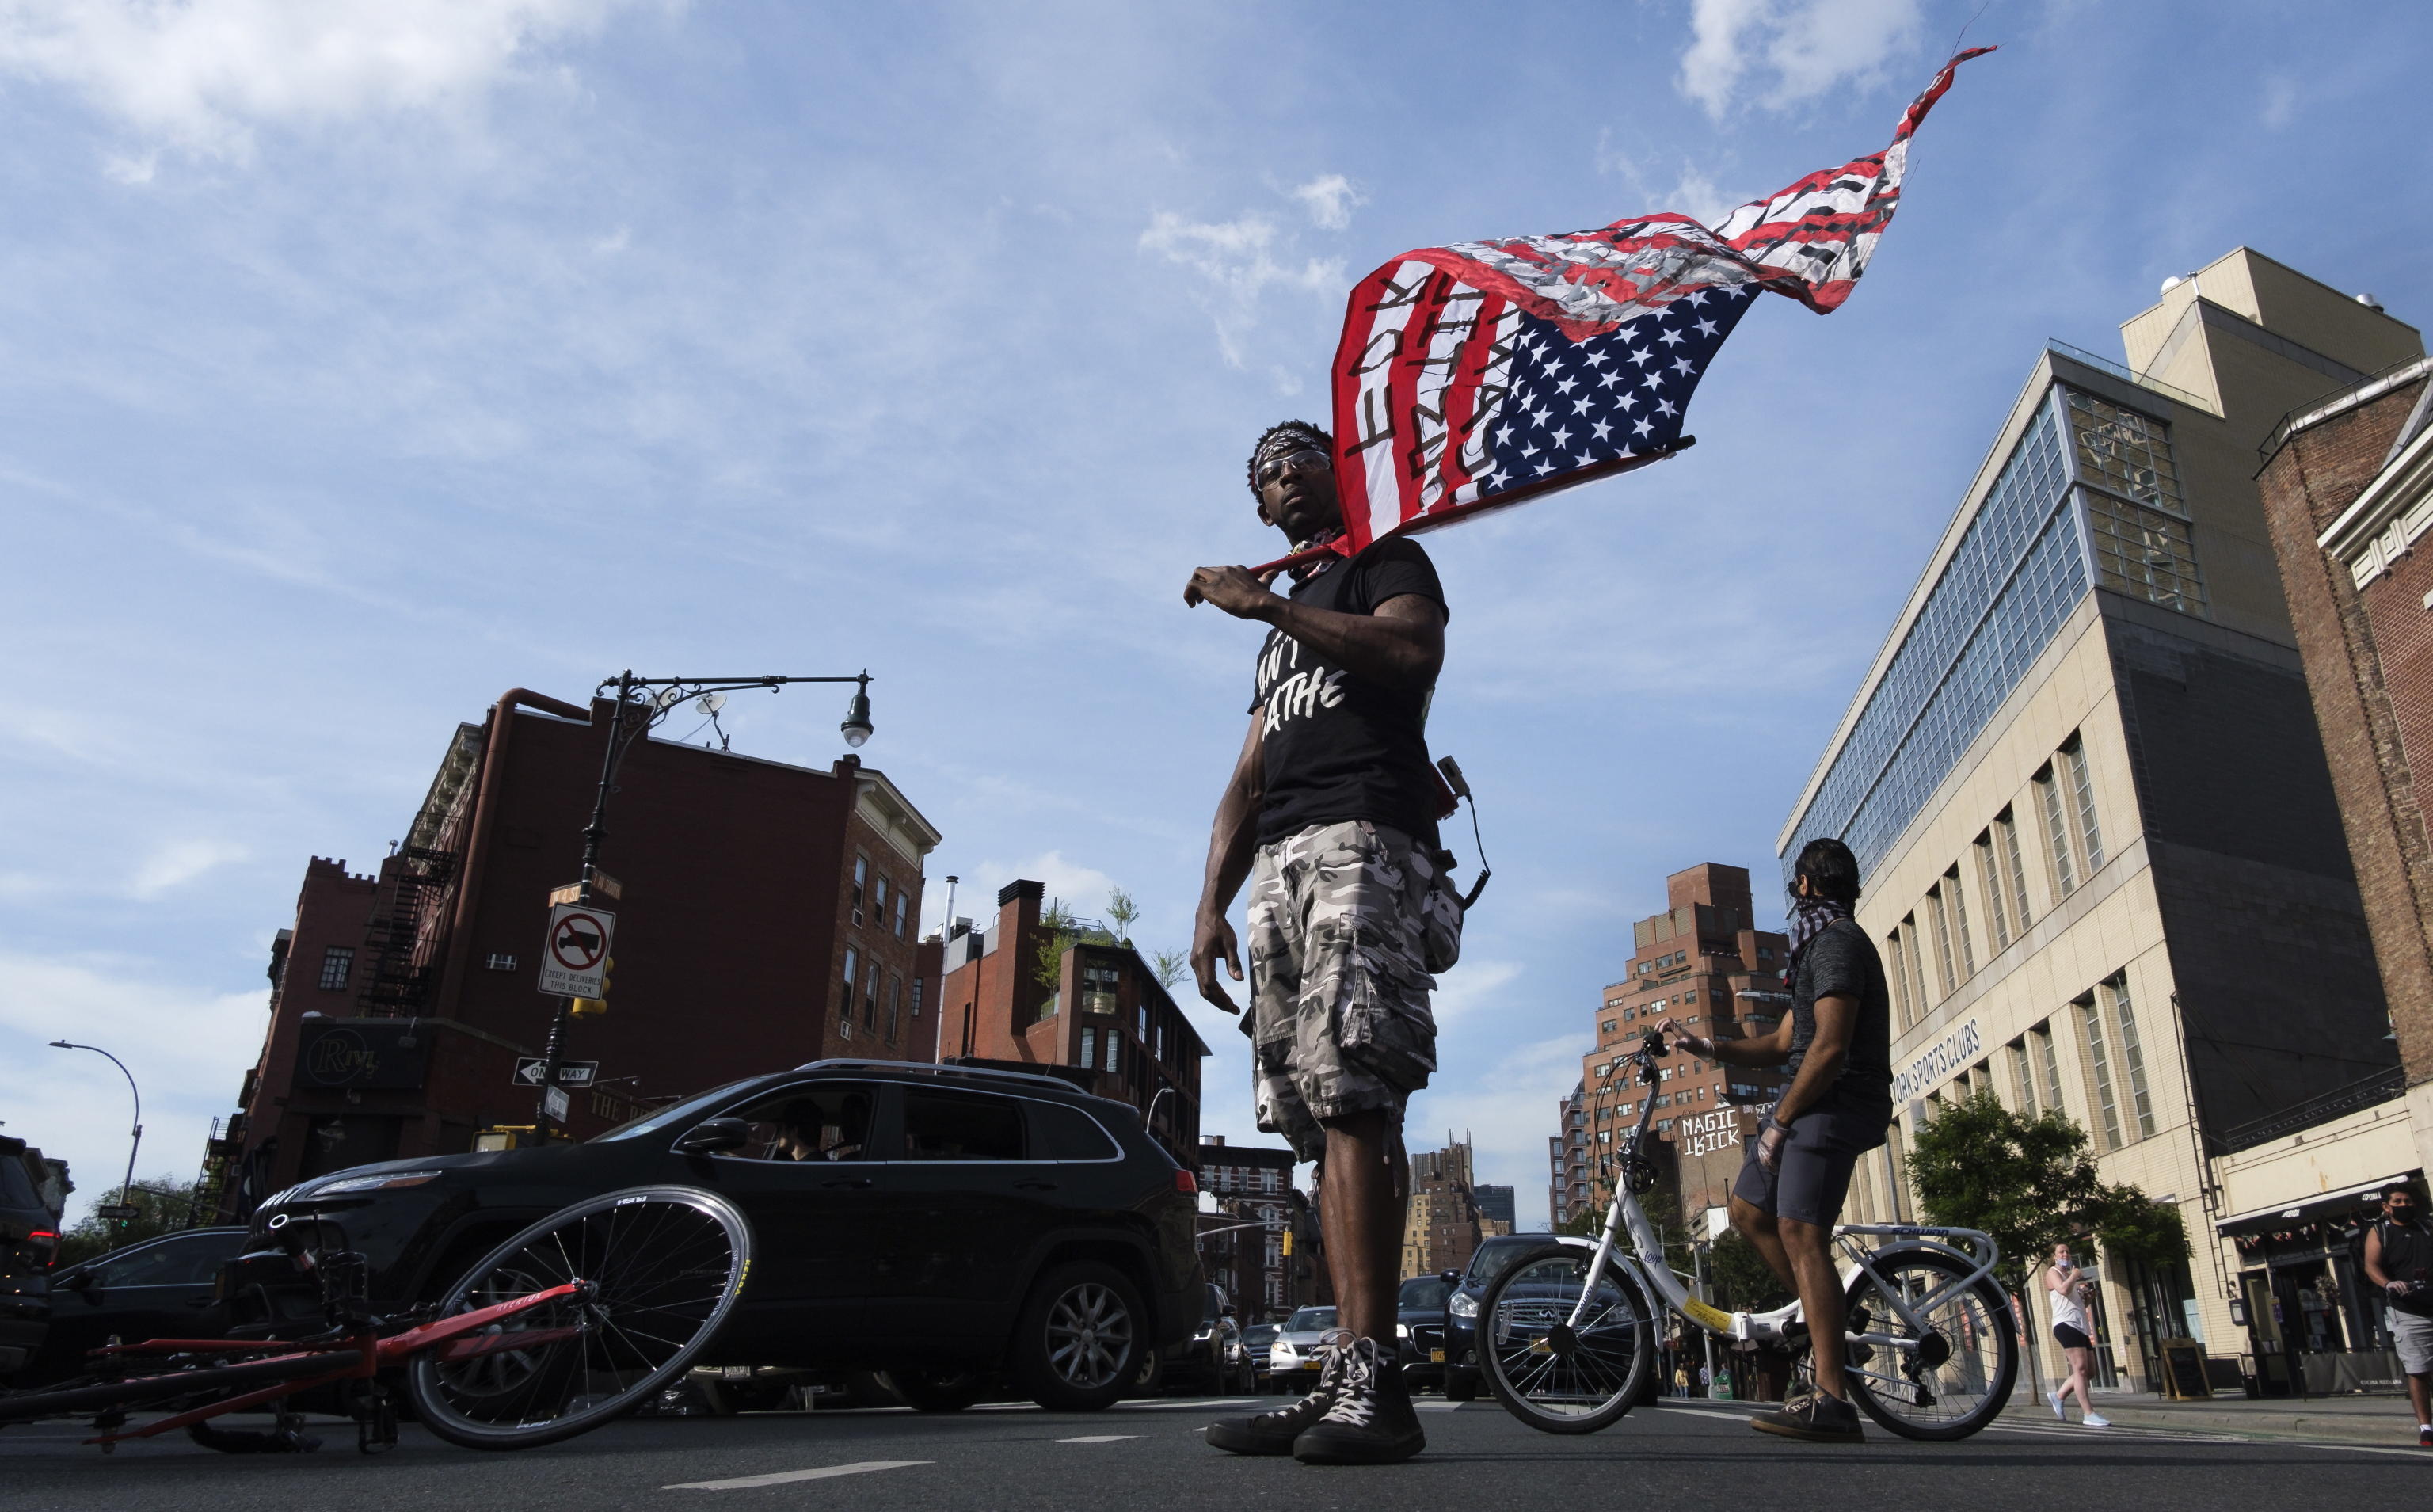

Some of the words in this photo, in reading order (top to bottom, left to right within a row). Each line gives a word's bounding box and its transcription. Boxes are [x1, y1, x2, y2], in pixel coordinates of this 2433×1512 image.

[544, 969, 566, 980] EXCEPT
[569, 973, 601, 986] DELIVERIES
[550, 981, 566, 990] THIS
[568, 984, 592, 995] BLOCK
[560, 1068, 585, 1079] WAY
[1891, 1068, 1913, 1106] YORK
[1912, 1042, 1947, 1092] SPORTS
[1946, 1018, 1980, 1068] CLUBS
[591, 1092, 621, 1122] THE
[1682, 1109, 1738, 1137] MAGIC
[1684, 1129, 1740, 1156] TRICK
[734, 1259, 752, 1295] KENDA
